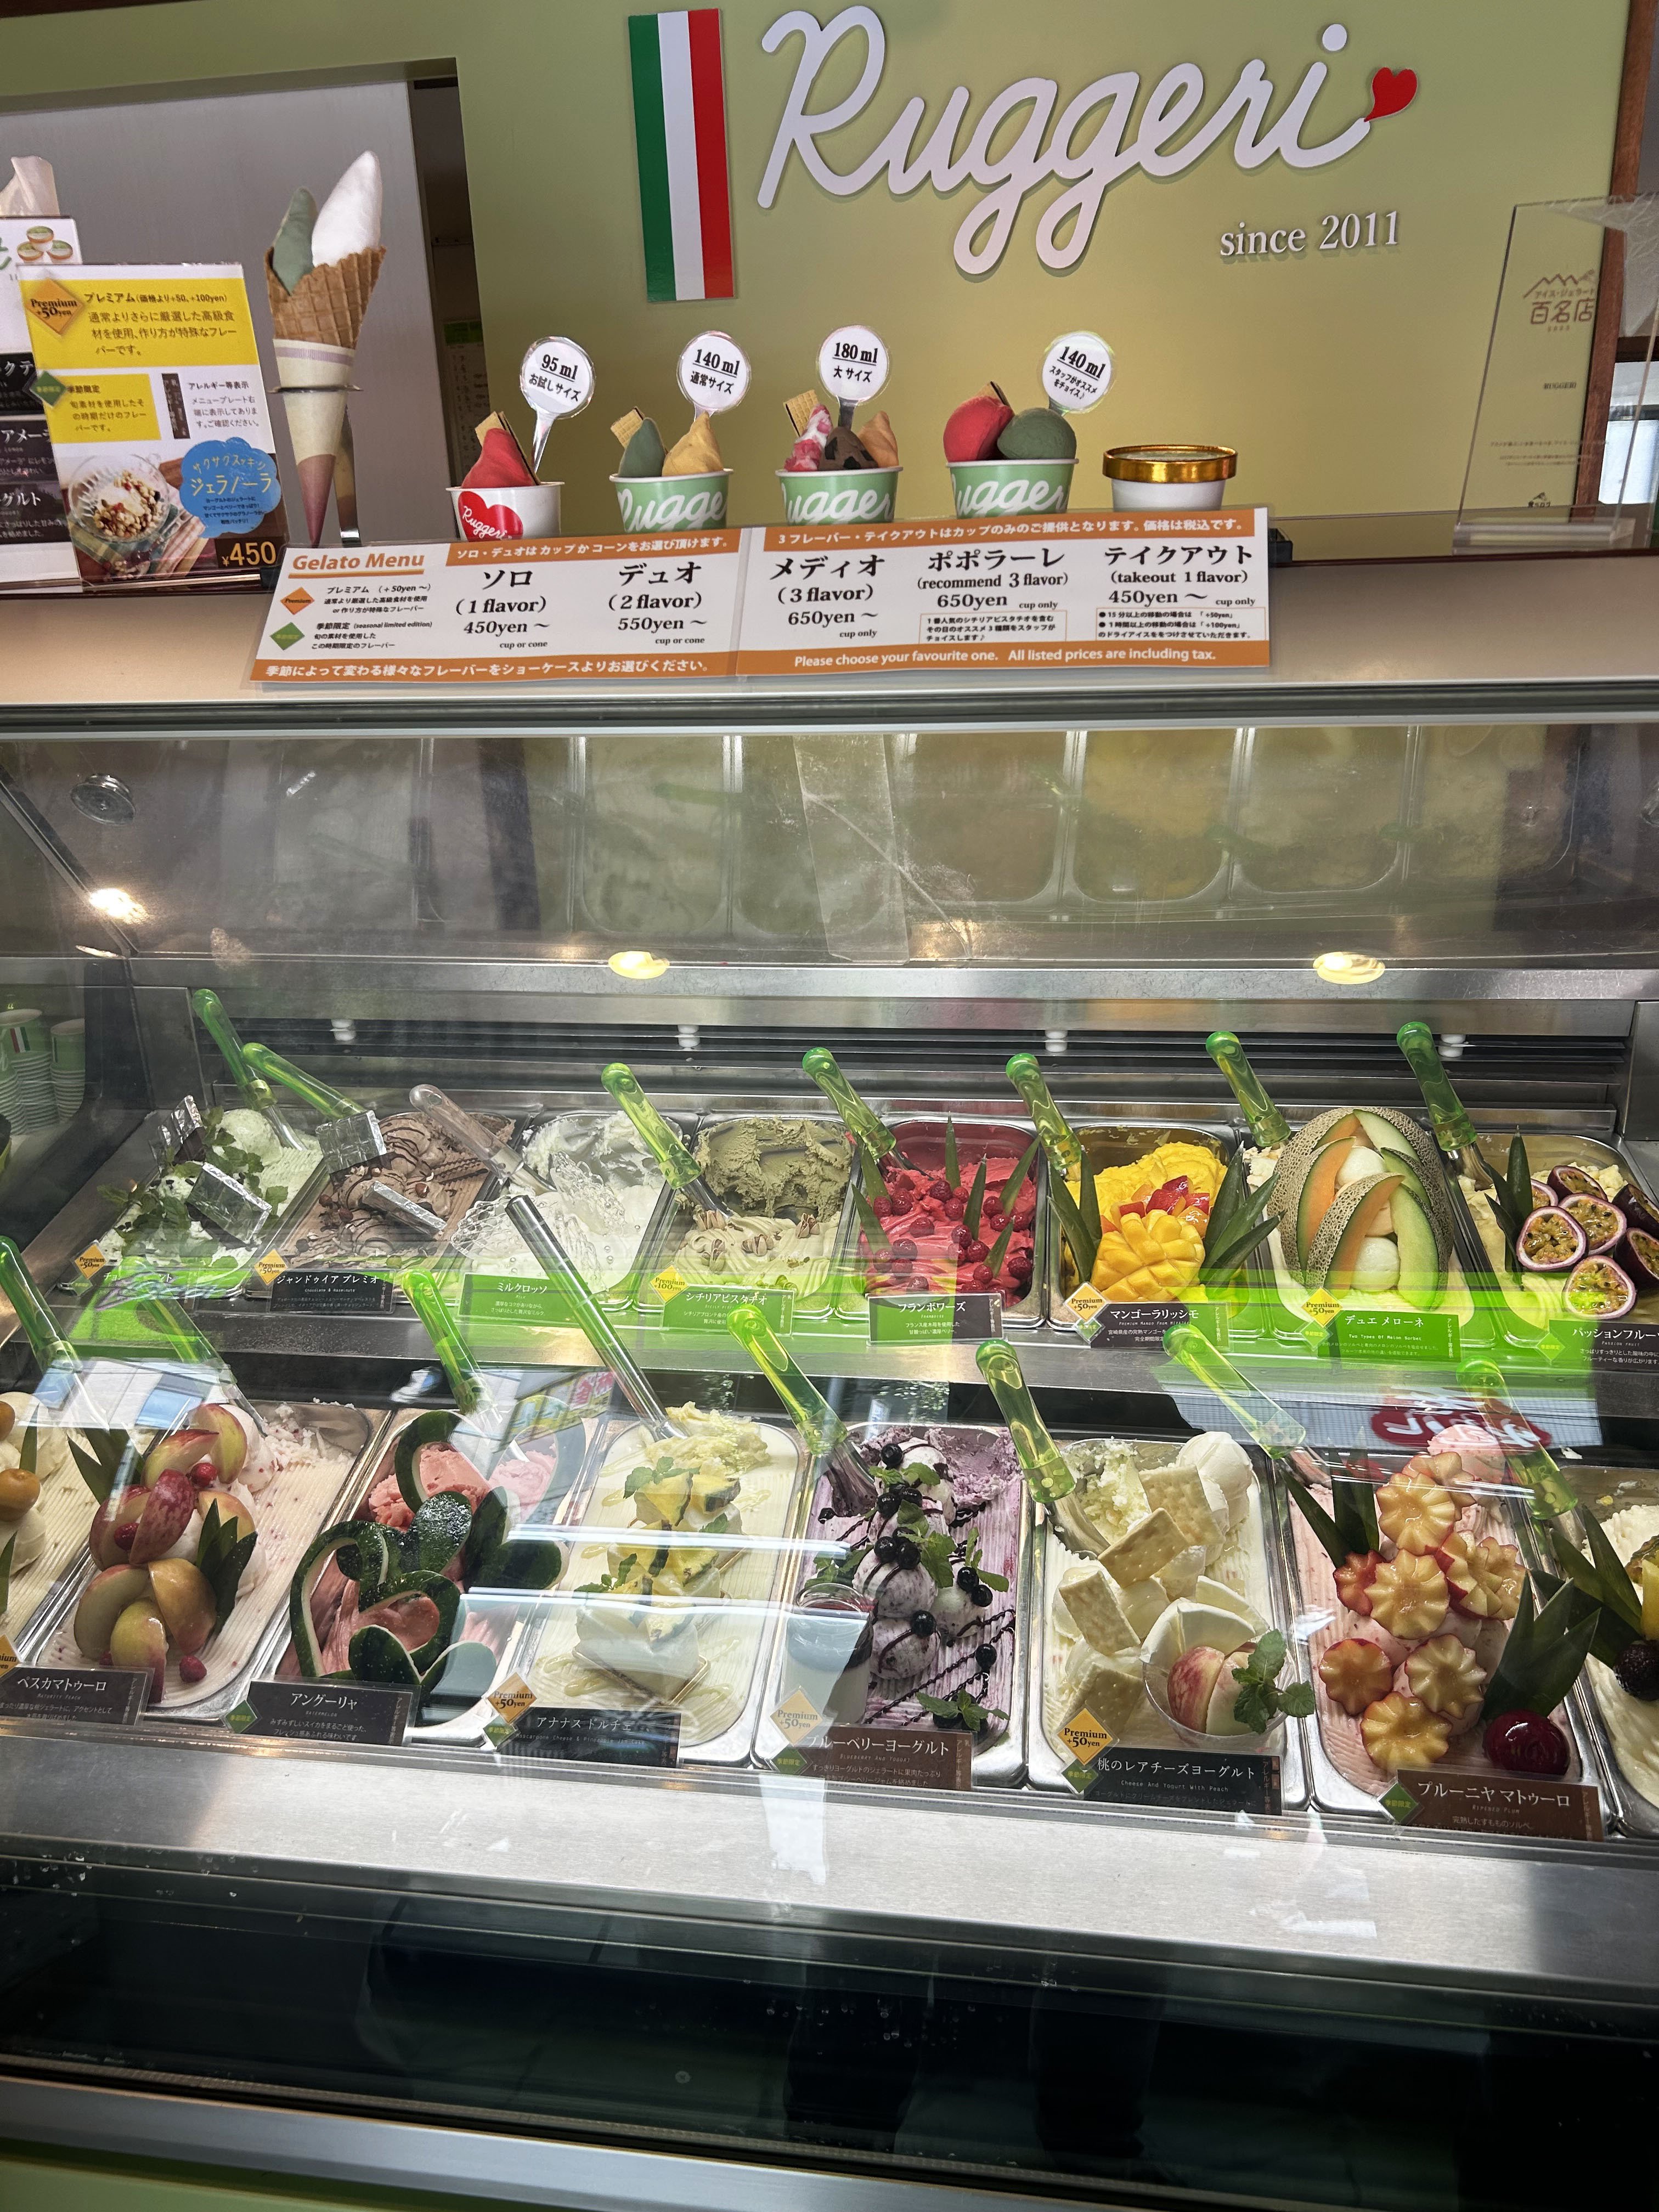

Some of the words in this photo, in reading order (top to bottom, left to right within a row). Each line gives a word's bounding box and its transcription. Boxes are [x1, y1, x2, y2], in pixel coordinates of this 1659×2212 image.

[758, 5, 1370, 274] Ruggeri
[1220, 221, 1306, 256] since
[1319, 211, 1399, 250] 2011
[31, 298, 77, 308] Premium
[1530, 298, 1595, 324] 百名店
[88, 310, 235, 323] 通常よりさらに厳選した高級食
[834, 342, 858, 359] 180
[860, 347, 878, 364] ml
[541, 354, 557, 372] 95
[560, 364, 578, 380] ml
[695, 349, 721, 368] 140
[723, 359, 741, 376] ml
[1060, 346, 1084, 368] 140
[1085, 358, 1106, 379] ml
[690, 371, 734, 394] 通常サイズ
[833, 366, 843, 379] 大
[846, 368, 873, 383] サイズ
[529, 373, 582, 402] お試しサイズ
[222, 541, 276, 567] ¥450
[292, 554, 360, 571] Gelato
[365, 552, 425, 568] Menu
[928, 548, 1065, 572] ポポラーレ
[1104, 545, 1252, 566] テイクアウト
[619, 561, 702, 585] デュオ
[769, 554, 885, 580] メディオ
[482, 569, 533, 590] ソロ
[917, 575, 1002, 590] (recommend
[1009, 574, 1020, 588] 3
[1023, 572, 1069, 587] flavor)
[1111, 570, 1177, 585] (takeout
[1184, 572, 1192, 582] 1
[1197, 569, 1249, 584] flavor)
[328, 586, 369, 594] プレミアム
[807, 583, 874, 602] flavor)
[1109, 590, 1178, 607] 450yen
[1216, 598, 1233, 606] cup
[1235, 597, 1256, 607] only
[483, 595, 547, 613] flavor)
[639, 591, 702, 610] flavor)
[937, 594, 1008, 611] 650yen
[1019, 602, 1036, 611] cup
[1038, 600, 1058, 611] only
[655, 637, 671, 646] cup
[839, 630, 856, 639] cup
[857, 628, 878, 639] only
[500, 641, 515, 650] cup
[528, 640, 548, 648] cone
[794, 656, 833, 667] Please
[836, 654, 879, 665] choose
[881, 654, 909, 665] your
[911, 651, 968, 663] favourite
[970, 652, 998, 662] one.
[1008, 650, 1025, 661] All
[1028, 649, 1063, 661] listed
[1065, 649, 1103, 663] prices
[1105, 650, 1126, 659] are
[1129, 648, 1189, 662] including
[1192, 650, 1216, 660] tax.
[266, 659, 709, 676] 季節によって変わる様々なフレーバーをショーケースよりお選びください。
[496, 1282, 548, 1294] ミルクロッソ
[656, 1277, 685, 1286] Premium
[898, 1301, 967, 1313] フランボワーズ
[1074, 1304, 1098, 1312] +50yen
[1110, 1308, 1199, 1319] マンゴーラリッシモ
[1345, 1314, 1378, 1325] デュエ
[1381, 1316, 1424, 1328] メローネ
[17, 1676, 107, 1692] ペスカマトゥーロ
[291, 1692, 357, 1710] アングーリャ
[493, 1690, 533, 1700] Premium
[495, 1697, 526, 1709] +50yen
[537, 1716, 582, 1729] アナナス
[777, 1709, 819, 1722] Premium
[780, 1718, 811, 1729] +50yen
[1063, 1728, 1108, 1740] Premium
[1066, 1737, 1101, 1748] +50yen
[806, 1734, 950, 1757] ブルーベリーヨーグルト
[1097, 1757, 1255, 1780] 桃のレアチーズヨーグルト
[1121, 1780, 1146, 1788] Cheese
[1163, 1782, 1186, 1791] Yogurt
[1209, 1785, 1229, 1793] Peach
[1500, 1789, 1570, 1808] マトゥーロ
